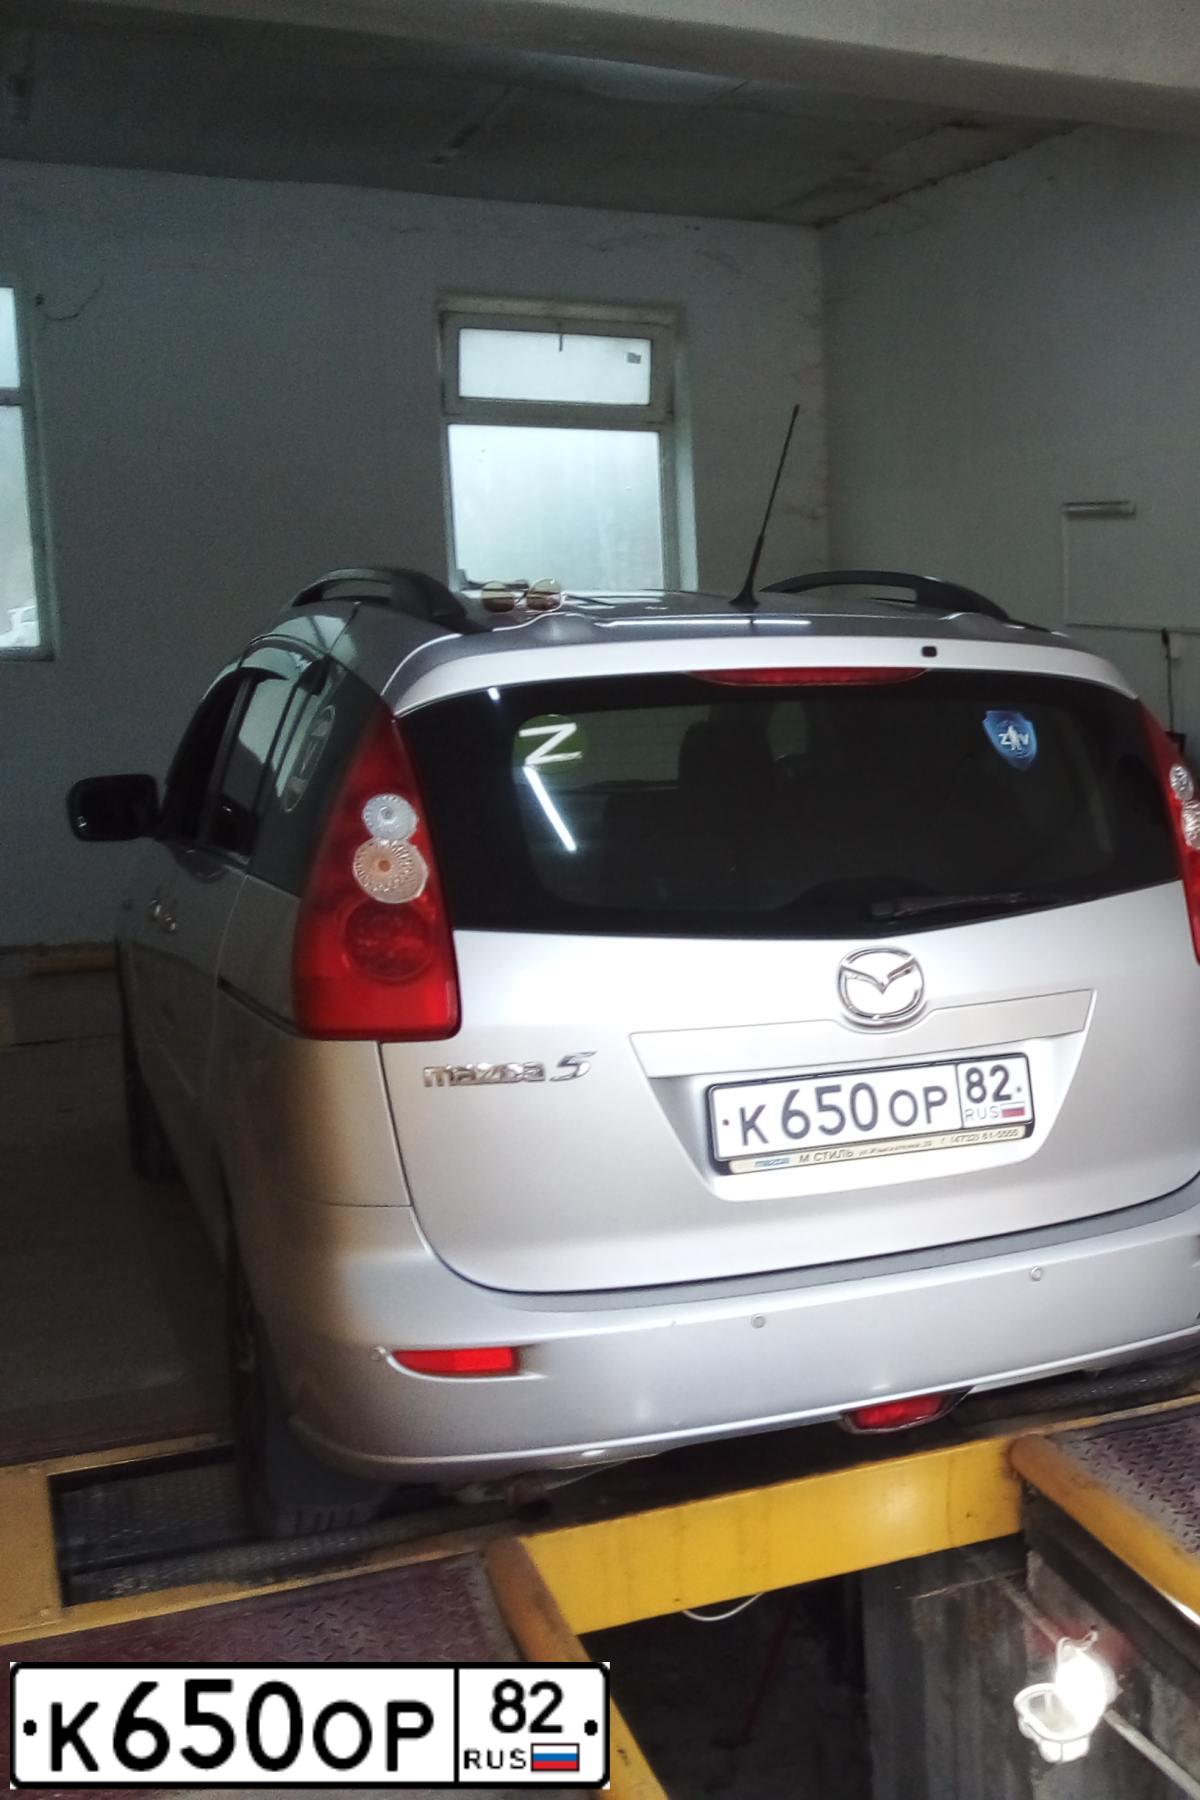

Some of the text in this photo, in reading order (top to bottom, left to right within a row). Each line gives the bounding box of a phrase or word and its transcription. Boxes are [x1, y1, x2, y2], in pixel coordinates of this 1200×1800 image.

[519, 723, 582, 766] Z
[423, 1050, 598, 1087] mazda 5
[965, 1064, 1012, 1104] 82
[964, 1105, 1000, 1121] RUS
[814, 1148, 854, 1162] СТИЛЬ
